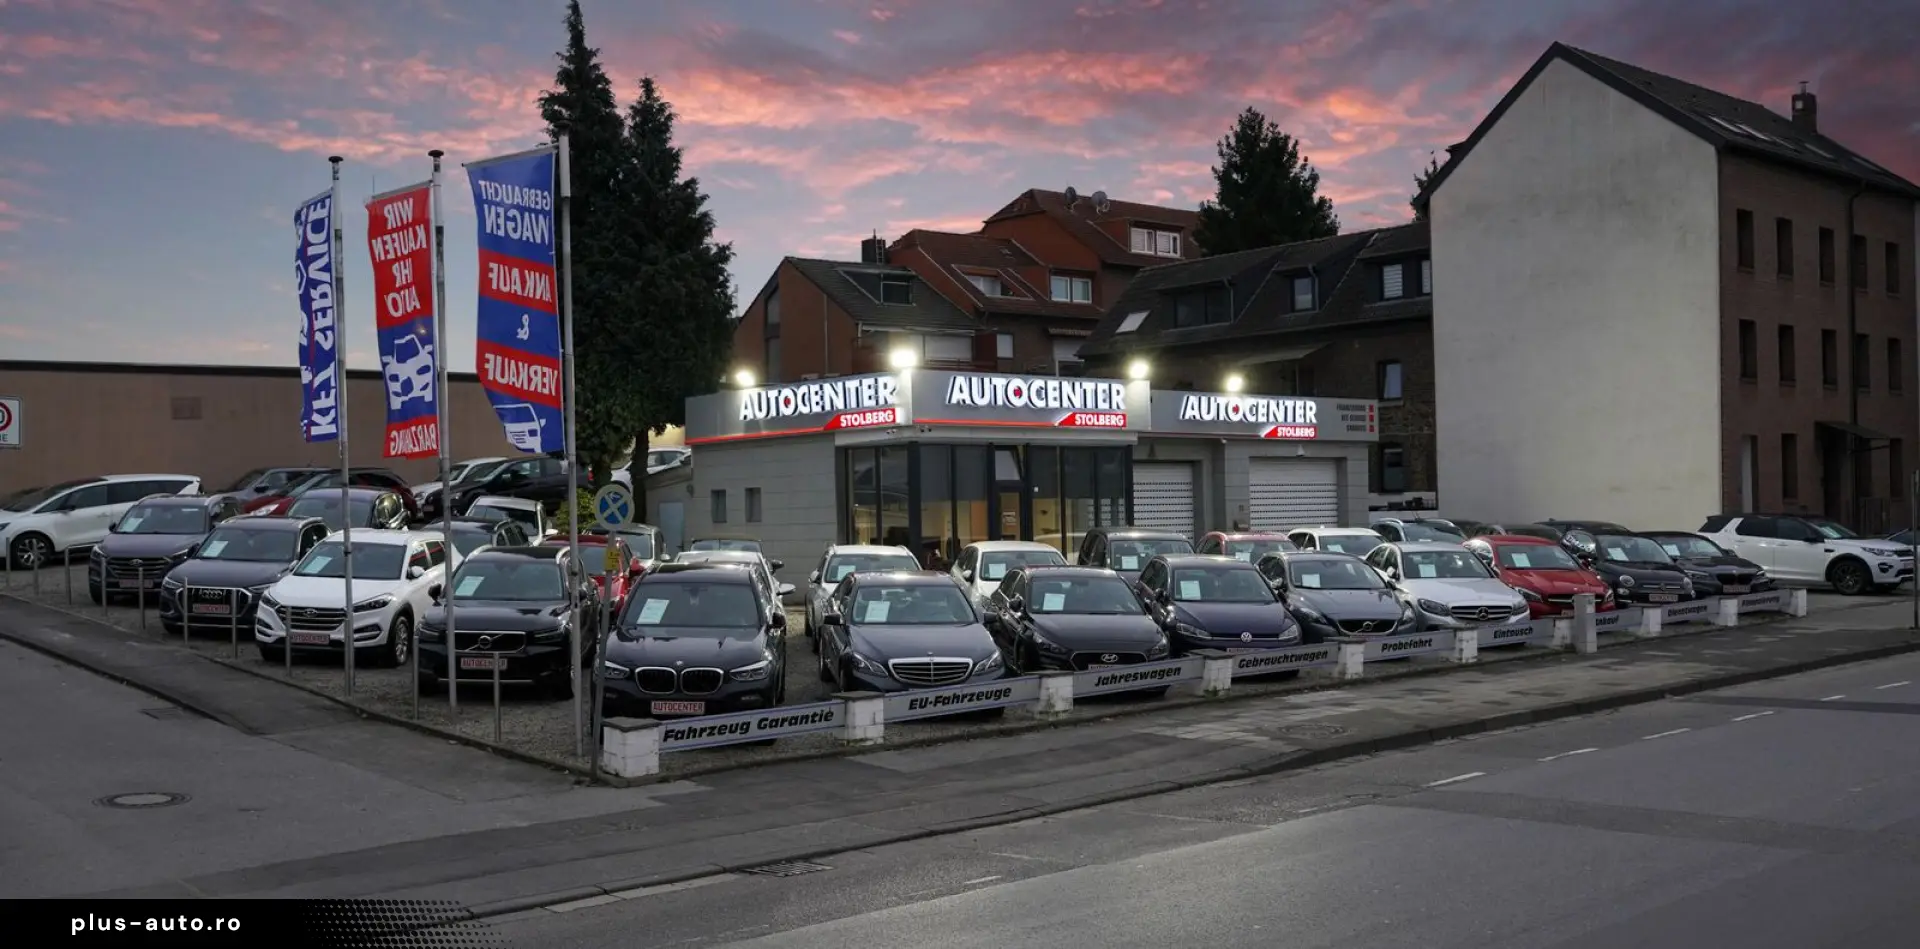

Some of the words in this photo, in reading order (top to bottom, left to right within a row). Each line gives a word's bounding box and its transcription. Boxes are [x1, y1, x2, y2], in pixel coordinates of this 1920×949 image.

[739, 376, 898, 421] AUTOCENTER
[946, 375, 1126, 410] AUTOCENTER
[839, 410, 895, 427] STOLBERG
[1180, 395, 1317, 423] AUTOCENTER
[1074, 413, 1125, 427] STOLBERG
[1277, 426, 1315, 438] STOLBERG
[1381, 637, 1433, 653] Probefahrt
[1238, 650, 1328, 669] Gebrauchtwagen
[1094, 666, 1181, 687] Jahreswagen
[653, 702, 704, 712] AUTOCENTER
[908, 685, 1012, 710] EU-Fahrzeuge
[662, 719, 750, 743] Fahrzeug
